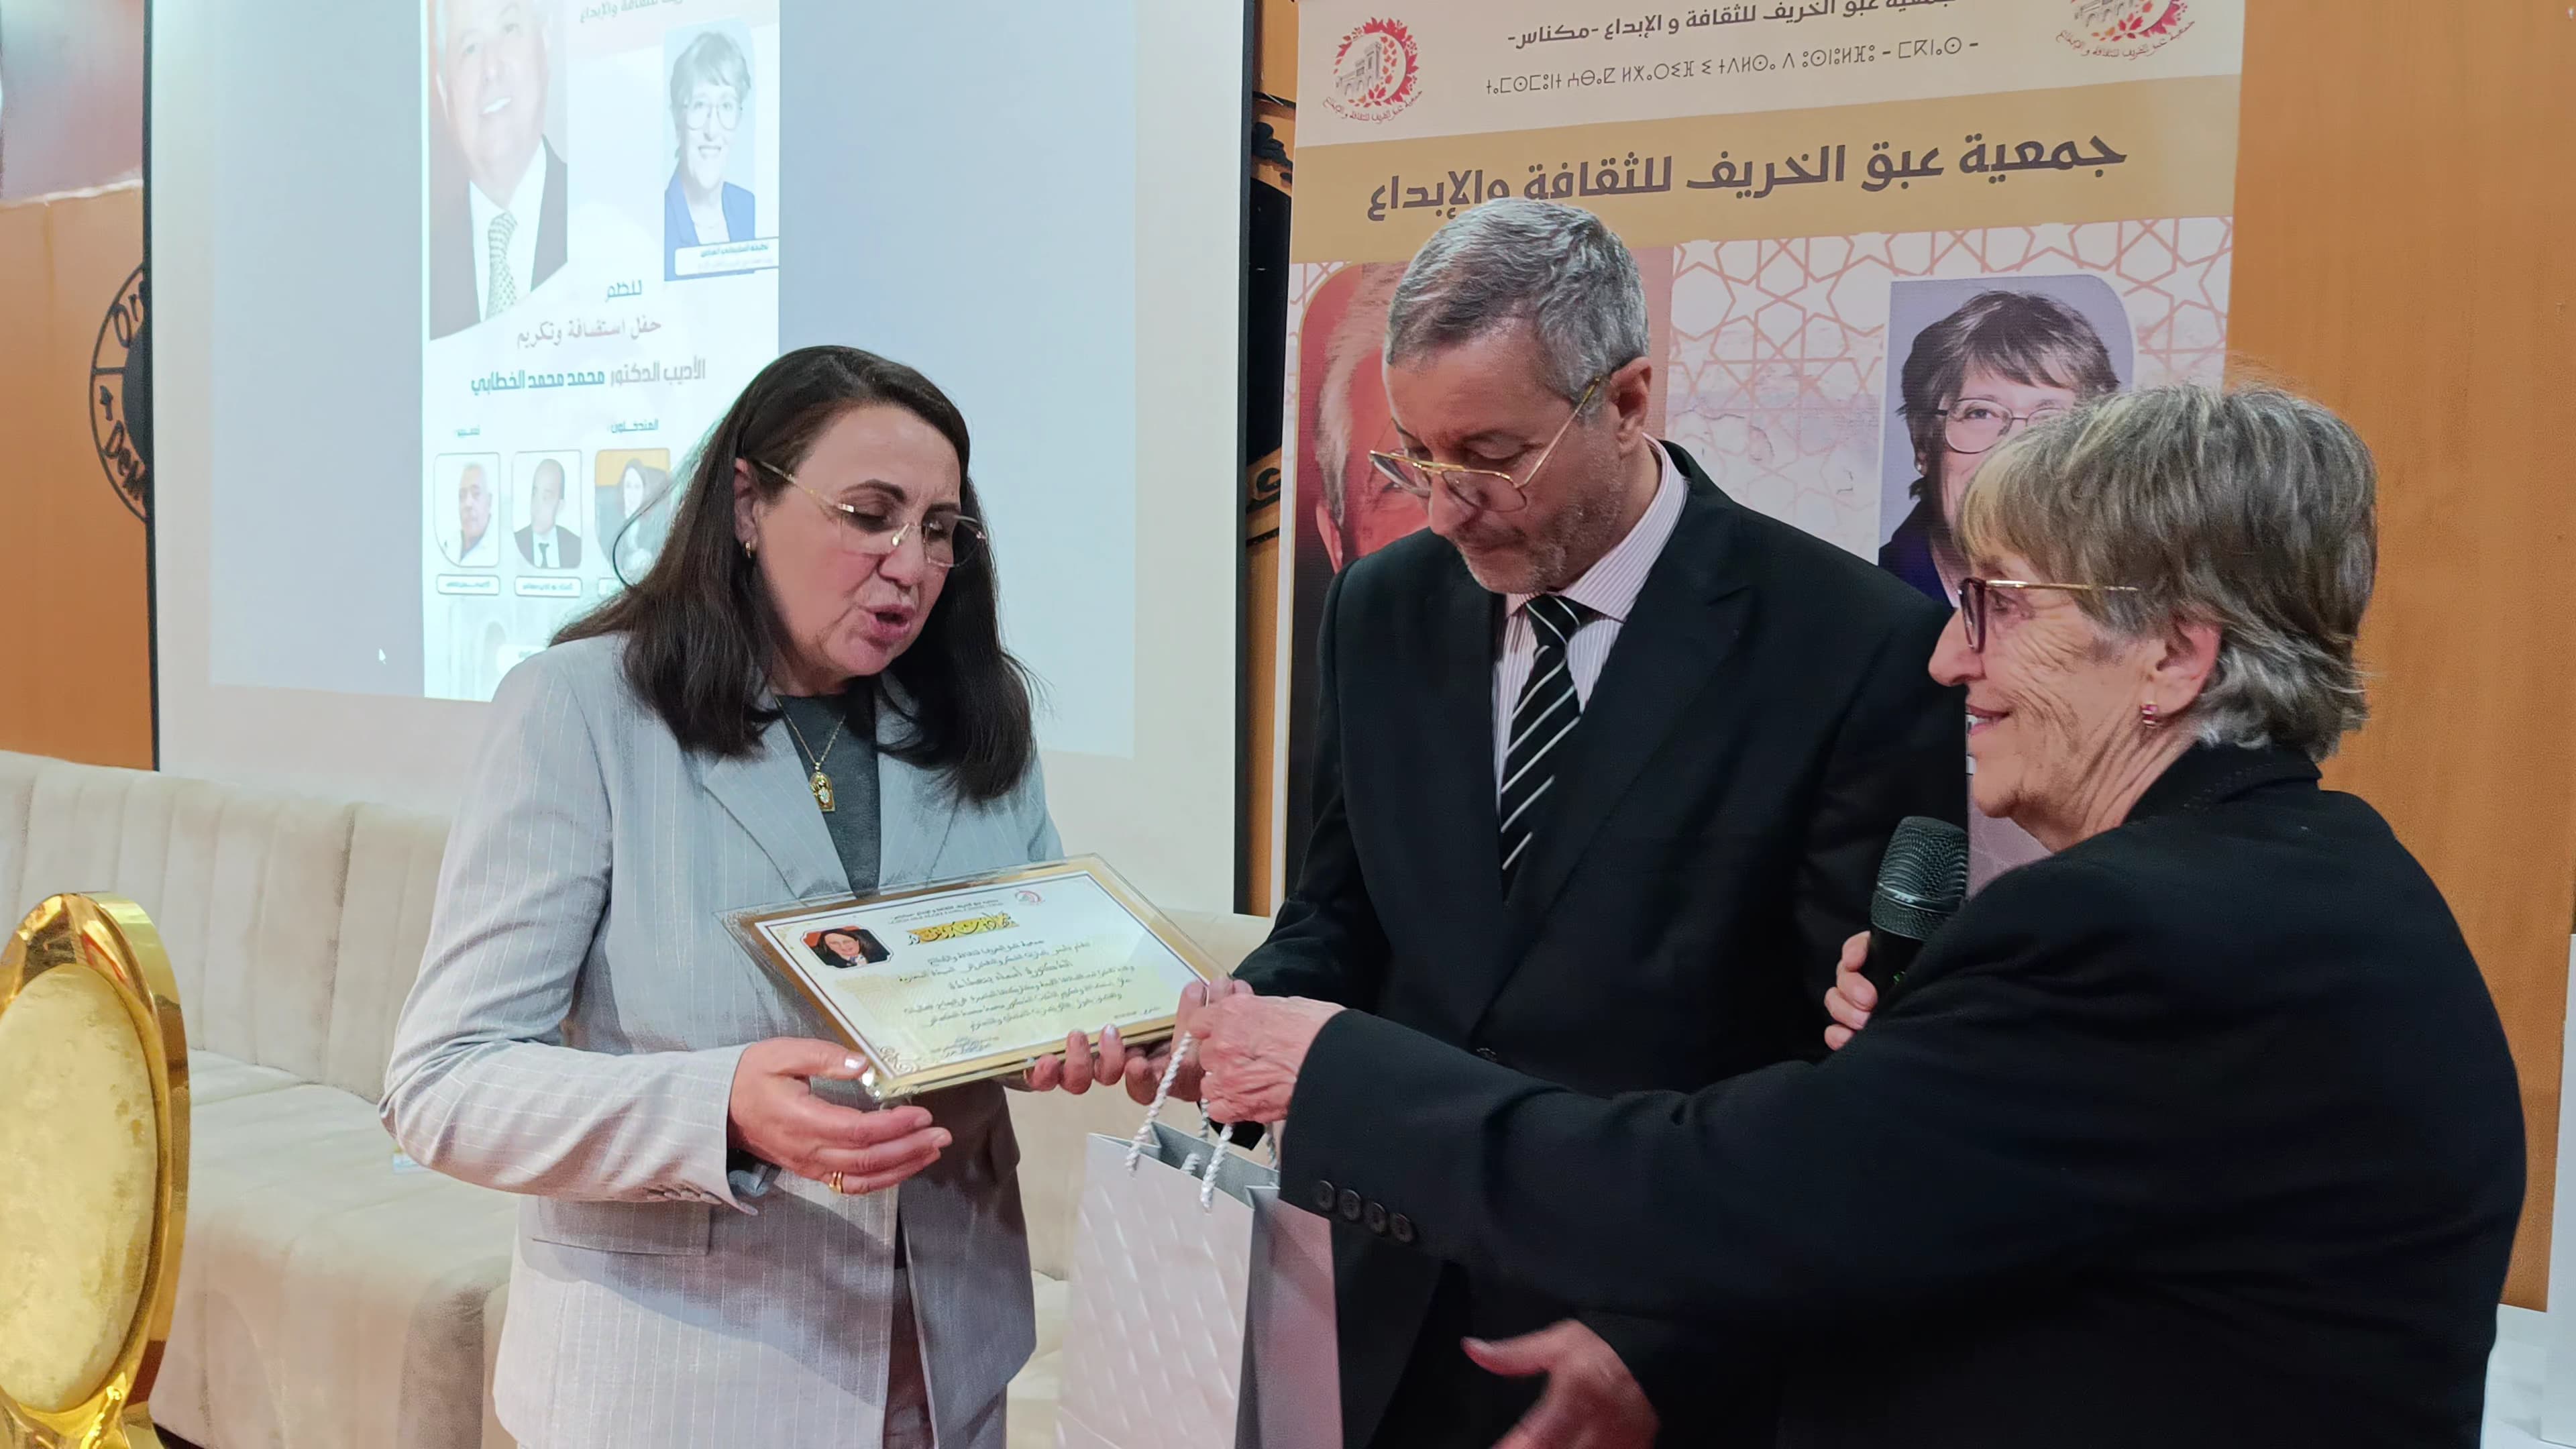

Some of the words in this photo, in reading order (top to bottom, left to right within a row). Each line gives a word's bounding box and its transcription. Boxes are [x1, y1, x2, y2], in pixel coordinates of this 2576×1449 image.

[1686, 3, 1756, 28] للثقافة
[1763, 0, 1835, 23] الخريف
[1604, 14, 1662, 40] الإبداع
[1668, 17, 1680, 34] و
[1686, 144, 1846, 199] الخريف
[1861, 141, 1945, 193] عبق
[1959, 133, 2127, 185] جمعية
[1523, 151, 1672, 201] للثقافة
[1367, 168, 1511, 222] والإبداع
[517, 321, 563, 349] وتكريم
[631, 315, 662, 340] حفل
[471, 369, 525, 396] الخطابي
[528, 372, 564, 389] محمد
[567, 370, 605, 386] محمد
[610, 360, 660, 388] الدكتور
[663, 355, 706, 385] الأديب
